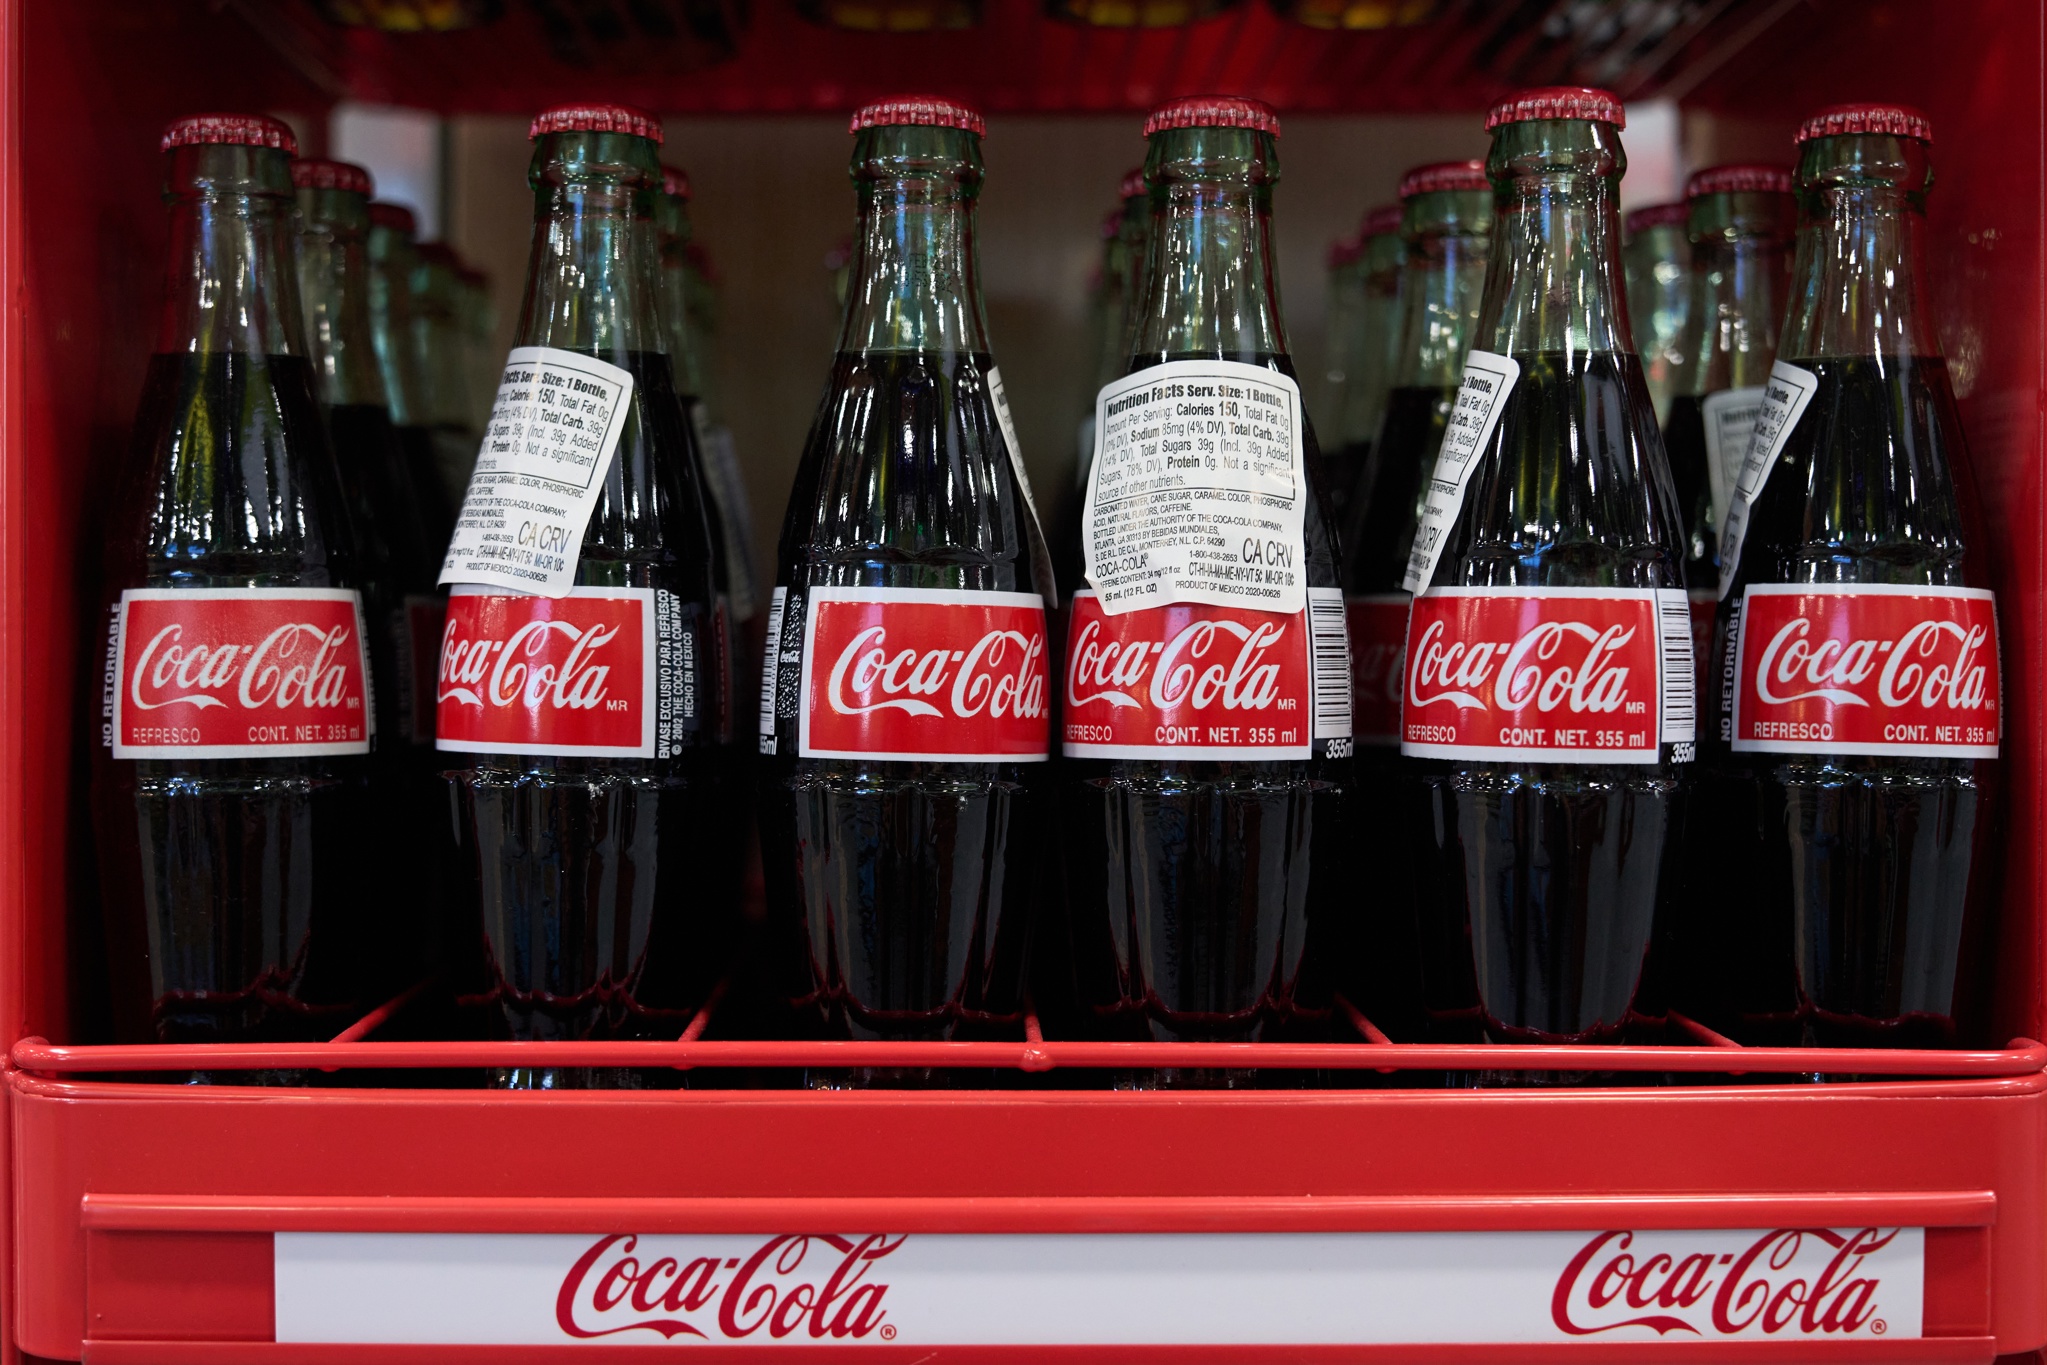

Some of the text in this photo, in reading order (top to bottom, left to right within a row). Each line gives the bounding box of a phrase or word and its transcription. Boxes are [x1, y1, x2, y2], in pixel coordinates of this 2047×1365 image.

[542, 372, 608, 402] Size: Bottle,
[538, 388, 609, 422] 150, Total Fat 0g
[1107, 384, 1284, 418] Nutrition Facts Serv. Size: Bottle,
[541, 408, 604, 438] Total Carb. 39g
[1106, 401, 1277, 436] Amount Per Serving: Calories 150, Total Fat
[551, 428, 598, 451] 39g Added
[1130, 422, 1289, 448] Sodium 85mg (4% DV), Total Carb. 39g
[525, 441, 593, 467] Not significant
[1140, 438, 1289, 463] Total Sugars 39g (Incl. 39g Added
[1100, 456, 1291, 486] Sugars, 78% DV), Protein 0g. Not significant
[542, 482, 584, 498] PHOSPHORIC
[1098, 474, 1186, 502] source of other nutrients.
[1093, 502, 1193, 528] ACID, NATURAL FLAVORS, CAFFEINE.
[1094, 490, 1293, 517] CARBONATED WATER, CANE SUGAR, CARAMEL COLOR, PHOSPHORIC
[518, 520, 572, 554] CA CRV
[1094, 514, 1283, 540] BOTTLED UNDER THE AUTHORITY OF THE COCA-COLA COMPANY,
[1094, 525, 1220, 551] ATLANTA, GA BY BEBIDAS MUNDIALES,
[1139, 536, 1226, 552] MONTERREY, N.L. C.P. 64290
[1190, 550, 1237, 562] 1-800-438-2653
[1242, 538, 1293, 568] CA CRV
[513, 567, 548, 582] 2020-00626
[1120, 572, 1146, 584] CONTENT:
[1265, 569, 1283, 585] MI-OR
[1146, 583, 1157, 593] OZ)
[1175, 580, 1280, 598] PRODUCT OF MEXICO 2020-00626
[103, 603, 121, 747] NO RETORNABLE
[132, 623, 350, 710] Coca-Cola
[658, 589, 671, 758] ENVASE EXCLUSIVO PARA REFRESCO
[670, 593, 683, 740] 2002 THE COCA-COLA COMPANY
[684, 632, 694, 717] HECHO EN MEXICO
[828, 626, 1044, 719] Coca-Cola
[1068, 619, 1287, 710] Coca-Cola
[1409, 619, 1637, 714] Coca-Cola
[1721, 598, 1742, 741] NO RETORNABLE
[1756, 617, 1988, 709] Coca-Cola
[347, 697, 360, 709] MR
[606, 700, 628, 711] MR
[1277, 699, 1297, 710] MR
[1626, 702, 1645, 714] MR
[1985, 699, 1995, 711] MR
[133, 725, 347, 743] REFRESCO CONT. NET. 355
[1066, 724, 1296, 743] REFRESCO CONT. NET. 355 ml
[1407, 725, 1645, 747] REFRESCO CONT. NET. 355 ml
[1754, 722, 1984, 743] REFRESCO CONT. NET. 355
[555, 1233, 908, 1341] Coca-Cola
[1551, 1227, 1901, 1336] Coca-Cola
